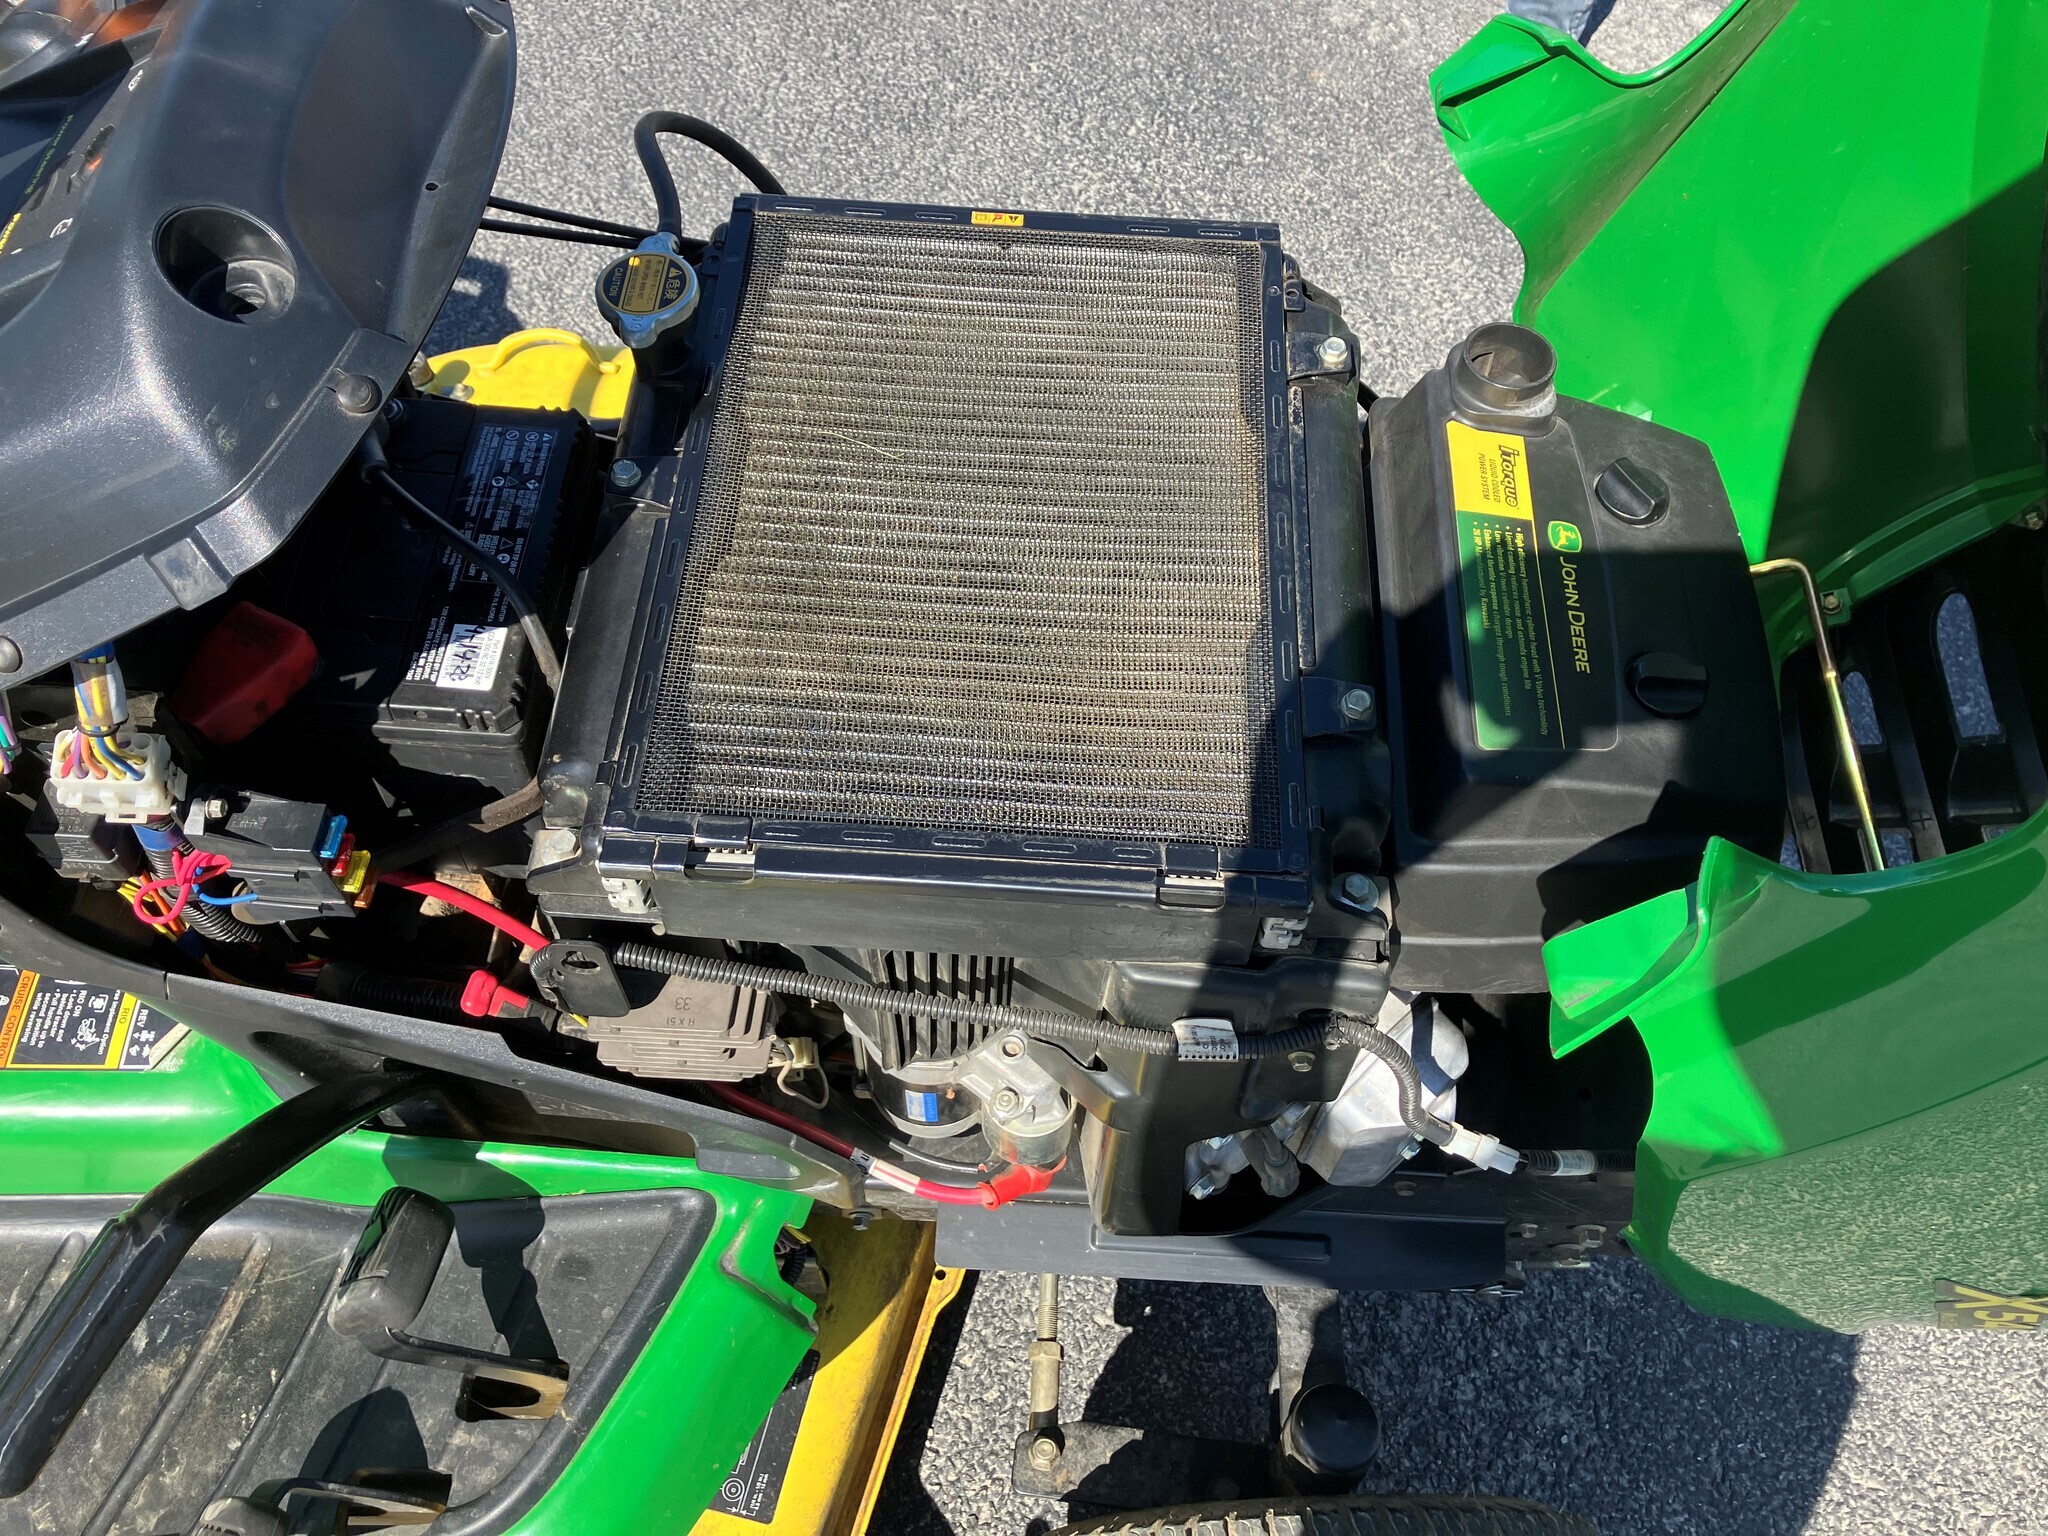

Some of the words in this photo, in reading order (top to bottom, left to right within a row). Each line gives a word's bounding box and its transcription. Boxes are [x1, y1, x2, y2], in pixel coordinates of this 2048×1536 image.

[608, 267, 624, 297] CAUTION
[1477, 452, 1487, 474] POWER
[1488, 458, 1497, 478] LIQUID
[1480, 474, 1489, 500] SYSTEM
[1499, 444, 1520, 508] iTorque
[1491, 478, 1500, 503] COOLED
[1504, 530, 1513, 551] Liquid
[1559, 554, 1582, 608] JOHN
[1514, 532, 1524, 547] High
[1537, 698, 1549, 736] technology
[1567, 608, 1592, 675] DEERE
[12, 976, 31, 1011] CRUISE
[32, 991, 42, 1010] while
[38, 991, 51, 1017] second
[51, 992, 60, 1006] Pull
[56, 992, 68, 1015] behind
[66, 992, 76, 1010] Look
[76, 988, 87, 1004] RIO
[674, 997, 691, 1010] 33
[43, 1005, 55, 1030] handle
[60, 1009, 71, 1029] down
[72, 1004, 82, 1017] ON
[118, 1006, 129, 1024] RIO
[137, 1009, 149, 1028] REV
[20, 1009, 36, 1043] reversing
[29, 1017, 42, 1046] position
[49, 1015, 61, 1038] tractor
[56, 1028, 64, 1042] and
[97, 1033, 108, 1055] Option
